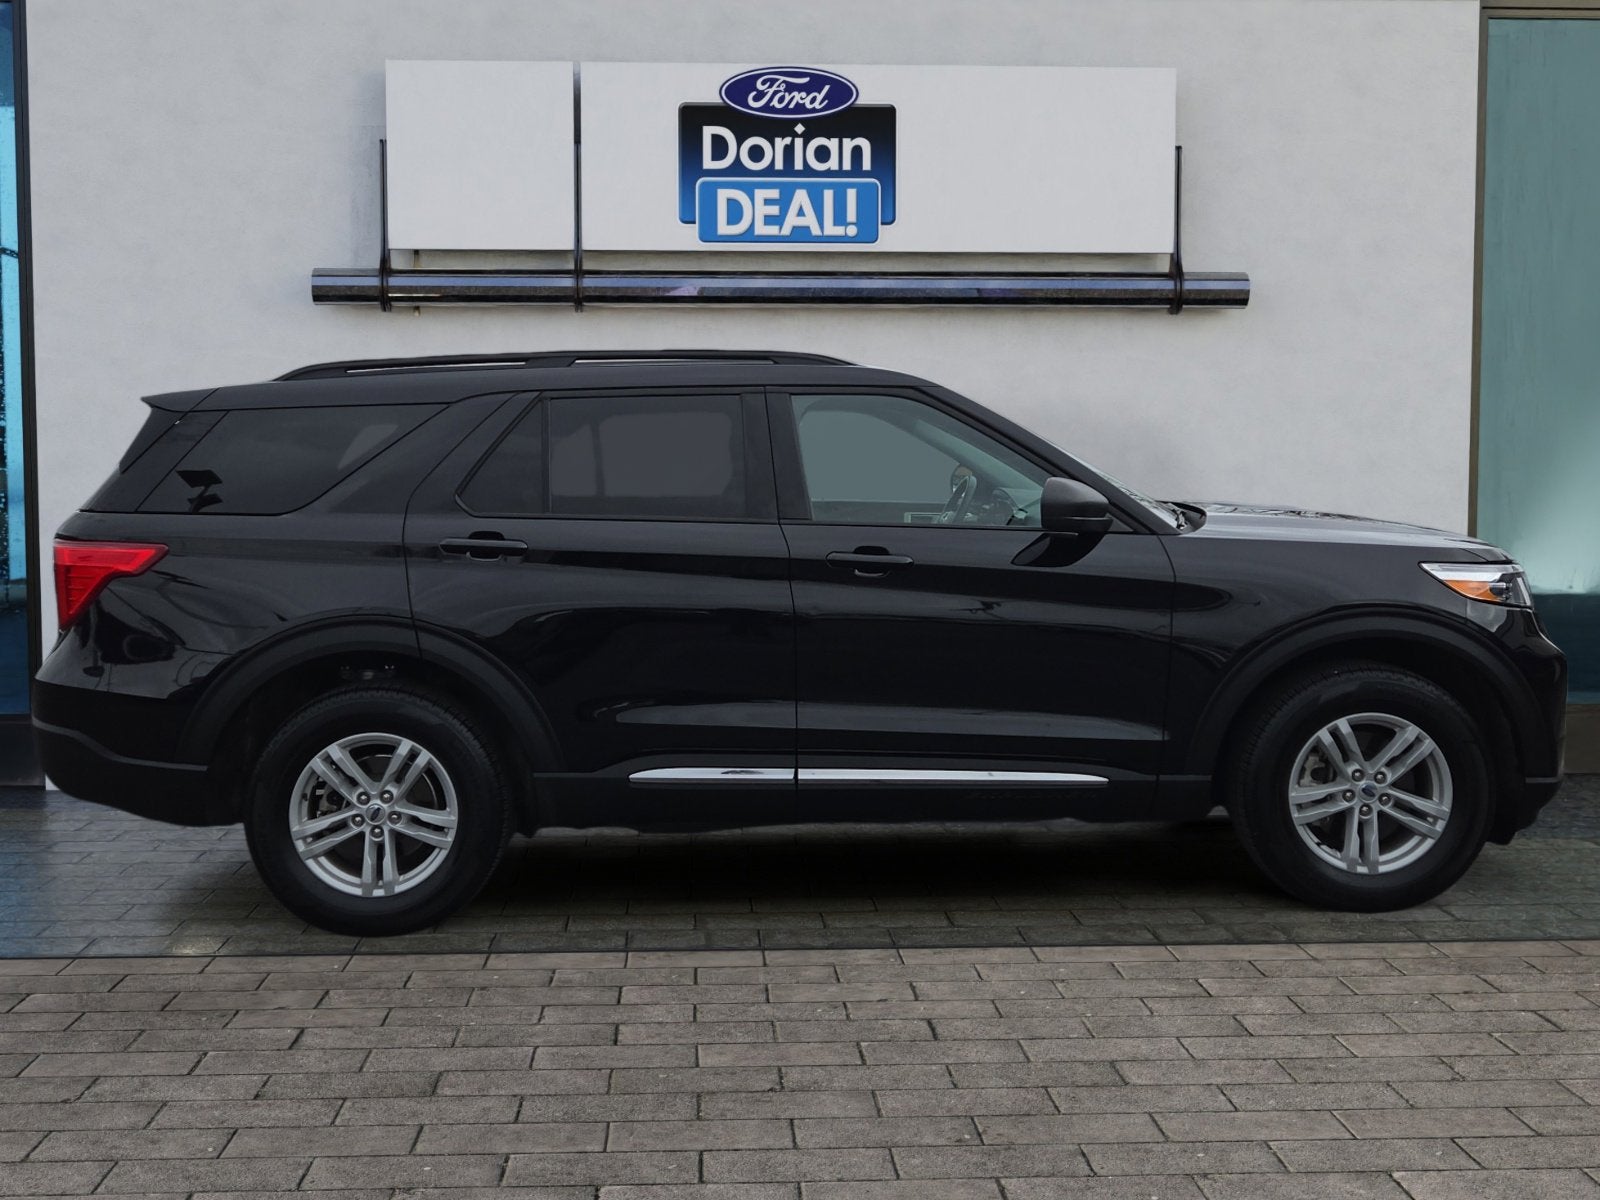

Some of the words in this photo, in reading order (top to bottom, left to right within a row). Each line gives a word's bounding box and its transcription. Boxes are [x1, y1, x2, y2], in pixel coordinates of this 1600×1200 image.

[747, 74, 830, 110] Ford
[702, 122, 871, 171] Dorian
[716, 188, 858, 237] DEAL!
